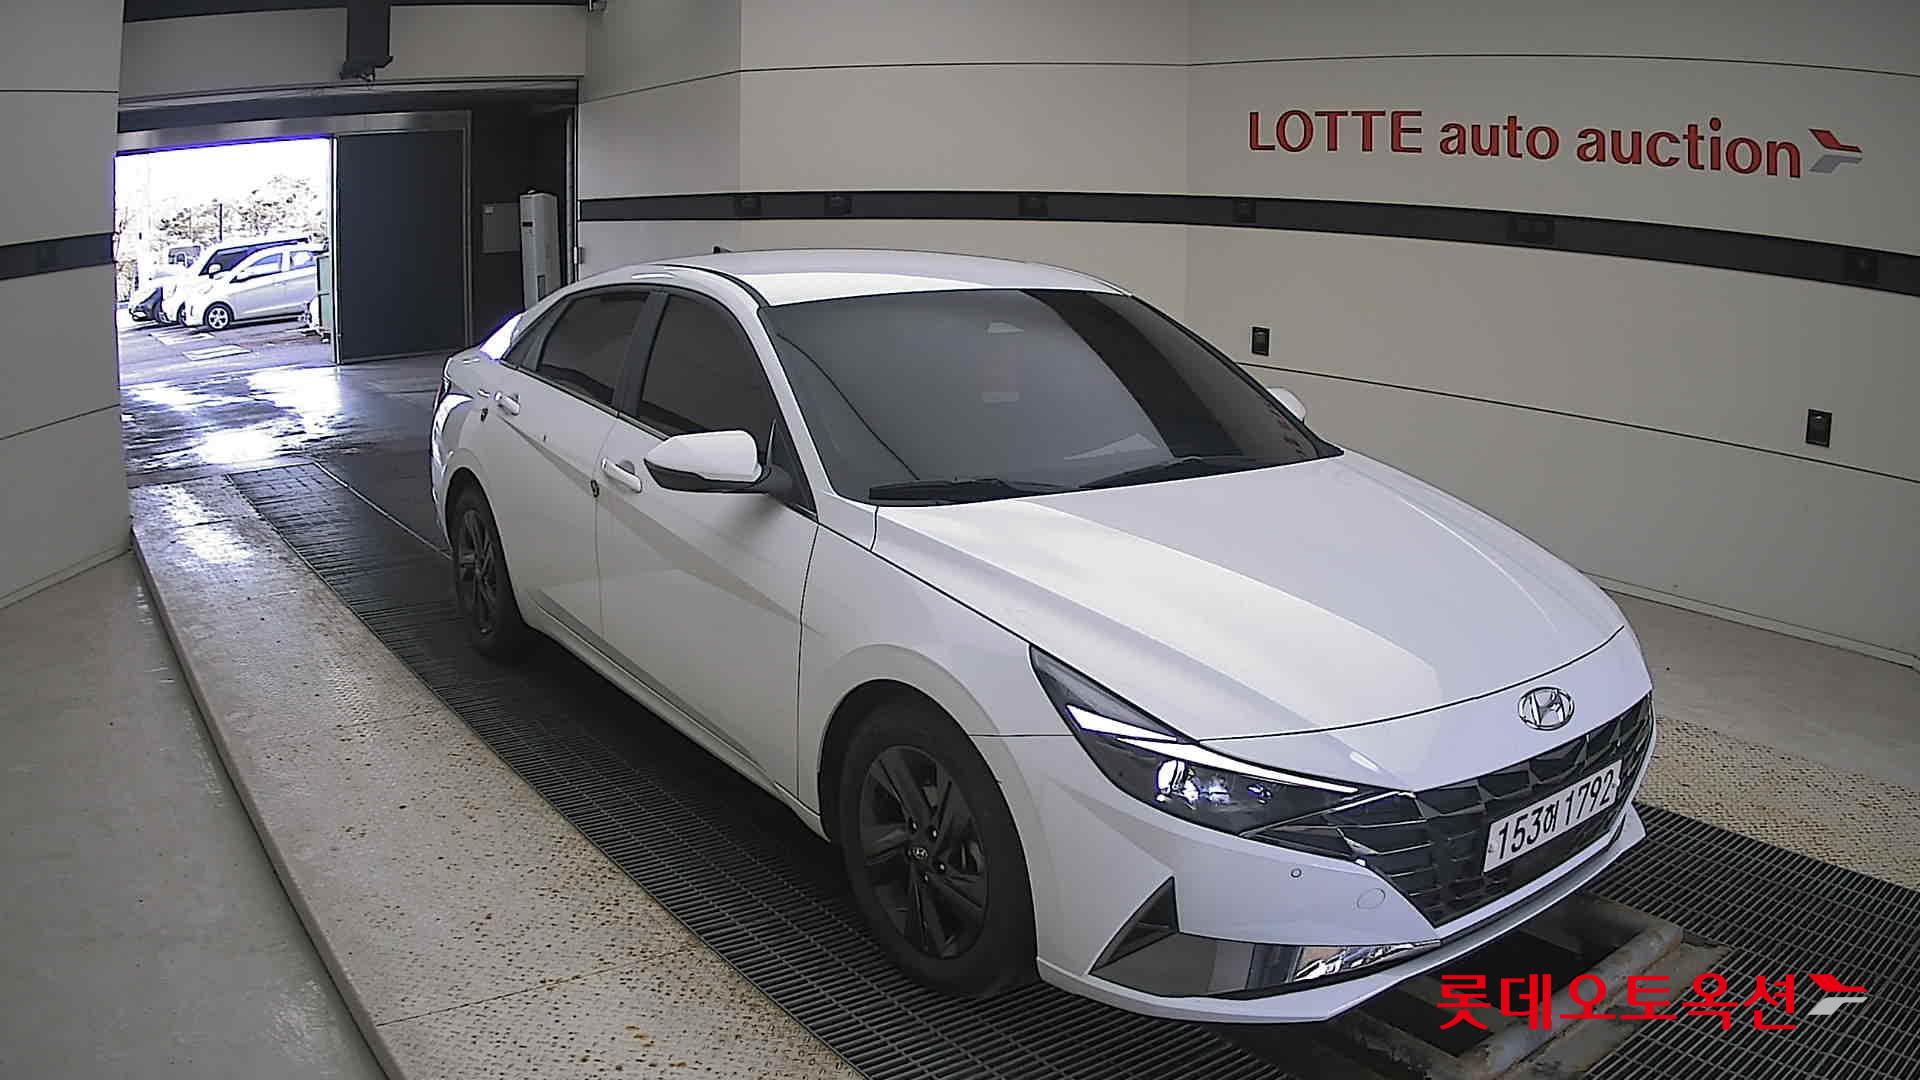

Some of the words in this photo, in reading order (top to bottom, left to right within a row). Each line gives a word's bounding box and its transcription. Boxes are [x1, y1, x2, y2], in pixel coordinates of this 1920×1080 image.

[1249, 110, 1423, 154] LOTTE
[1438, 115, 1560, 161] auto
[1575, 117, 1802, 179] auction
[1565, 768, 1615, 826] 1792
